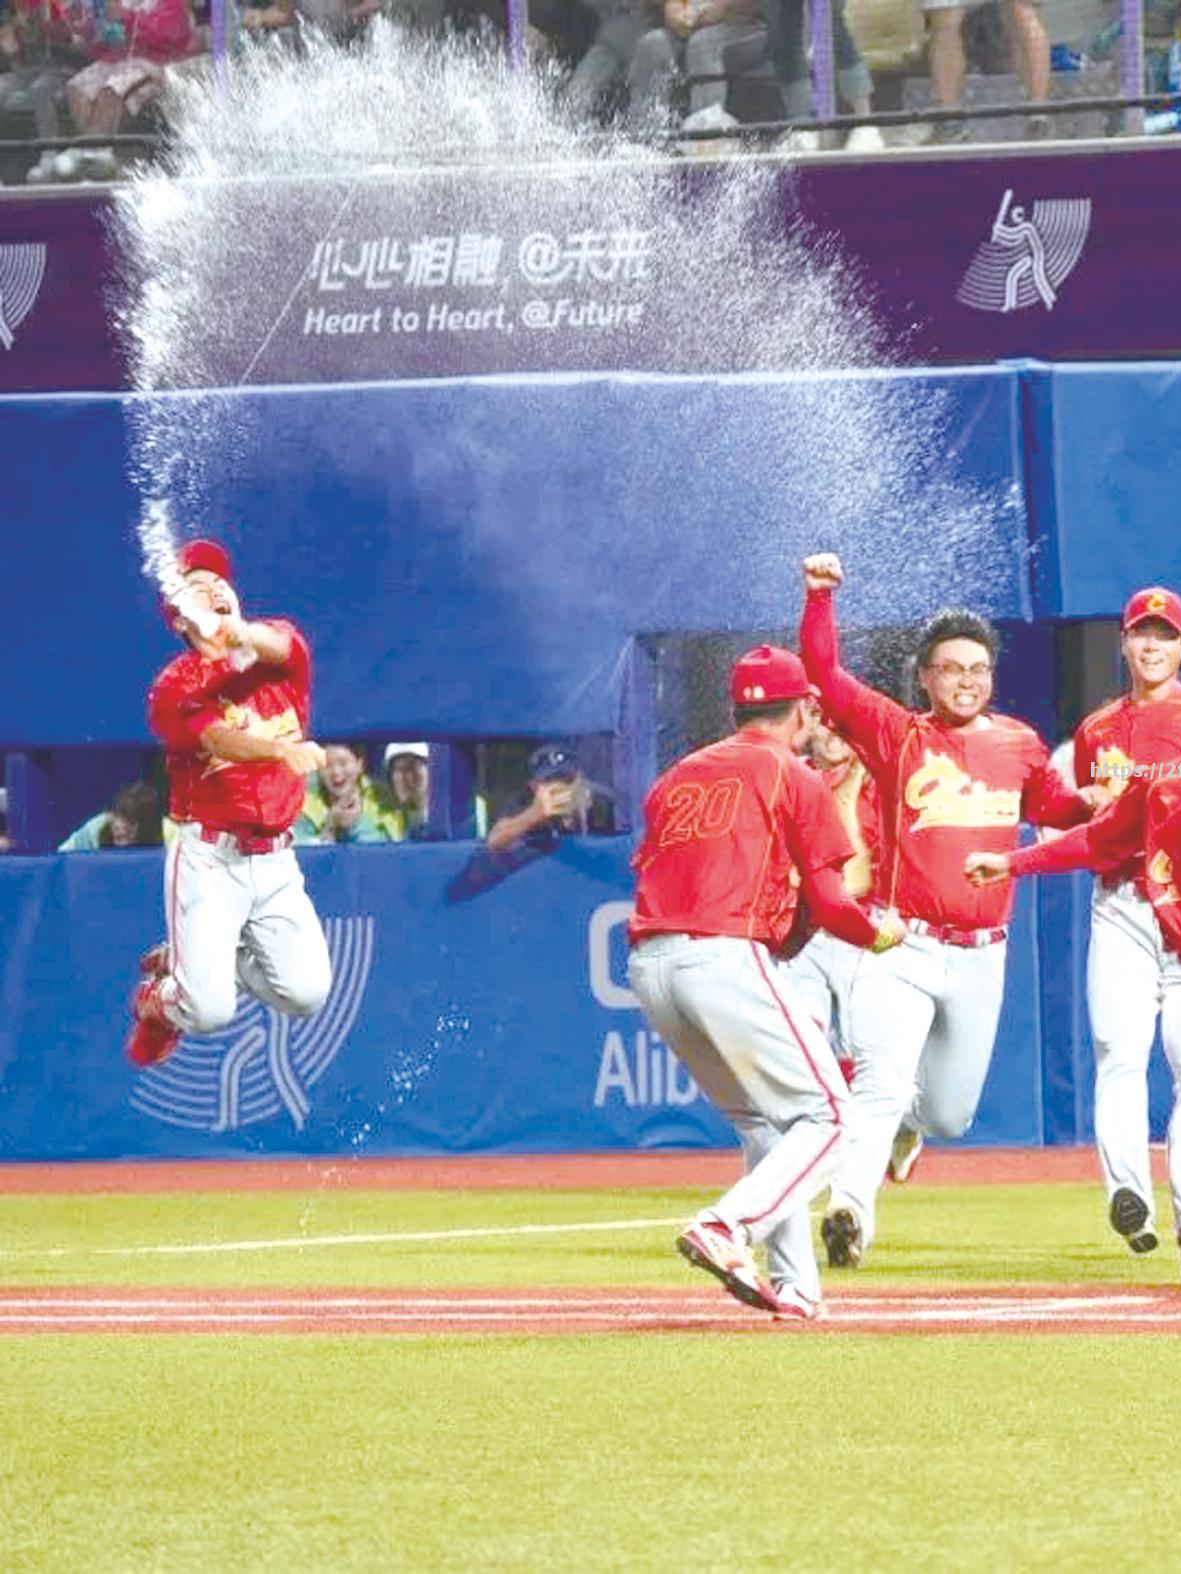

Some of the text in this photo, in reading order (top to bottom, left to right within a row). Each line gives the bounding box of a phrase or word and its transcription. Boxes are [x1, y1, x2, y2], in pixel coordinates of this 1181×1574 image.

[303, 307, 381, 335] Heart
[392, 305, 420, 333] to
[426, 303, 514, 333] Heart,
[659, 776, 744, 847] 20
